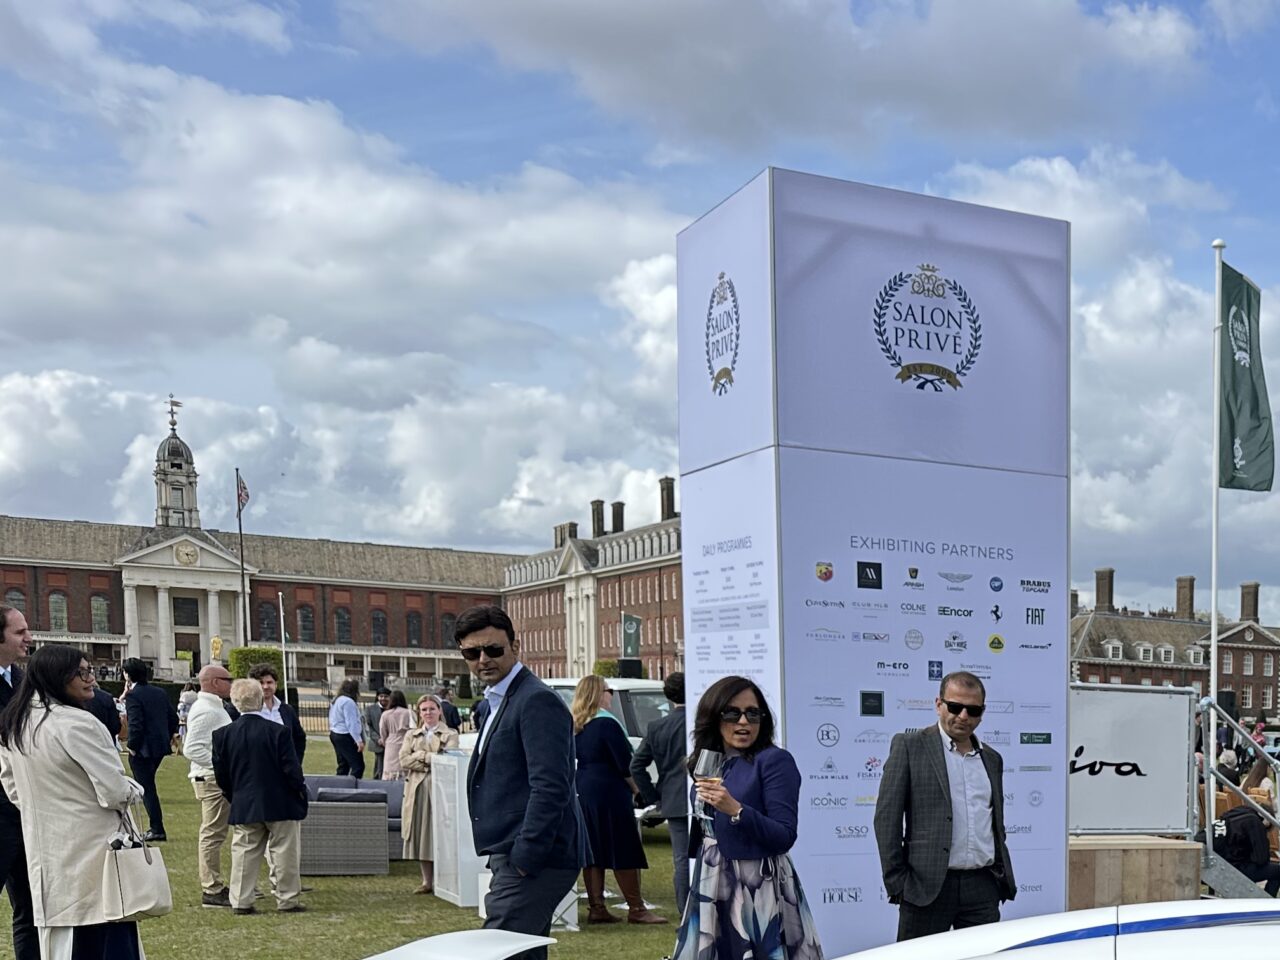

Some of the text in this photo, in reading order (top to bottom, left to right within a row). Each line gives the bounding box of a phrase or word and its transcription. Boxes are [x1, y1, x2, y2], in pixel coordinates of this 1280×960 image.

[710, 307, 734, 337] SALON
[892, 301, 963, 330] SALON
[711, 328, 734, 361] PRIVÉ
[893, 327, 963, 356] PRIVÉ
[850, 535, 1014, 561] EXHIBITING PARTNERS
[1020, 579, 1052, 588] BRABUS
[900, 602, 927, 612] COLNE
[1025, 607, 1046, 626] FIAT
[810, 797, 848, 807] ICONIC
[835, 825, 869, 835] SASSO
[1020, 884, 1043, 893] Street
[822, 890, 863, 904] HOUSE
